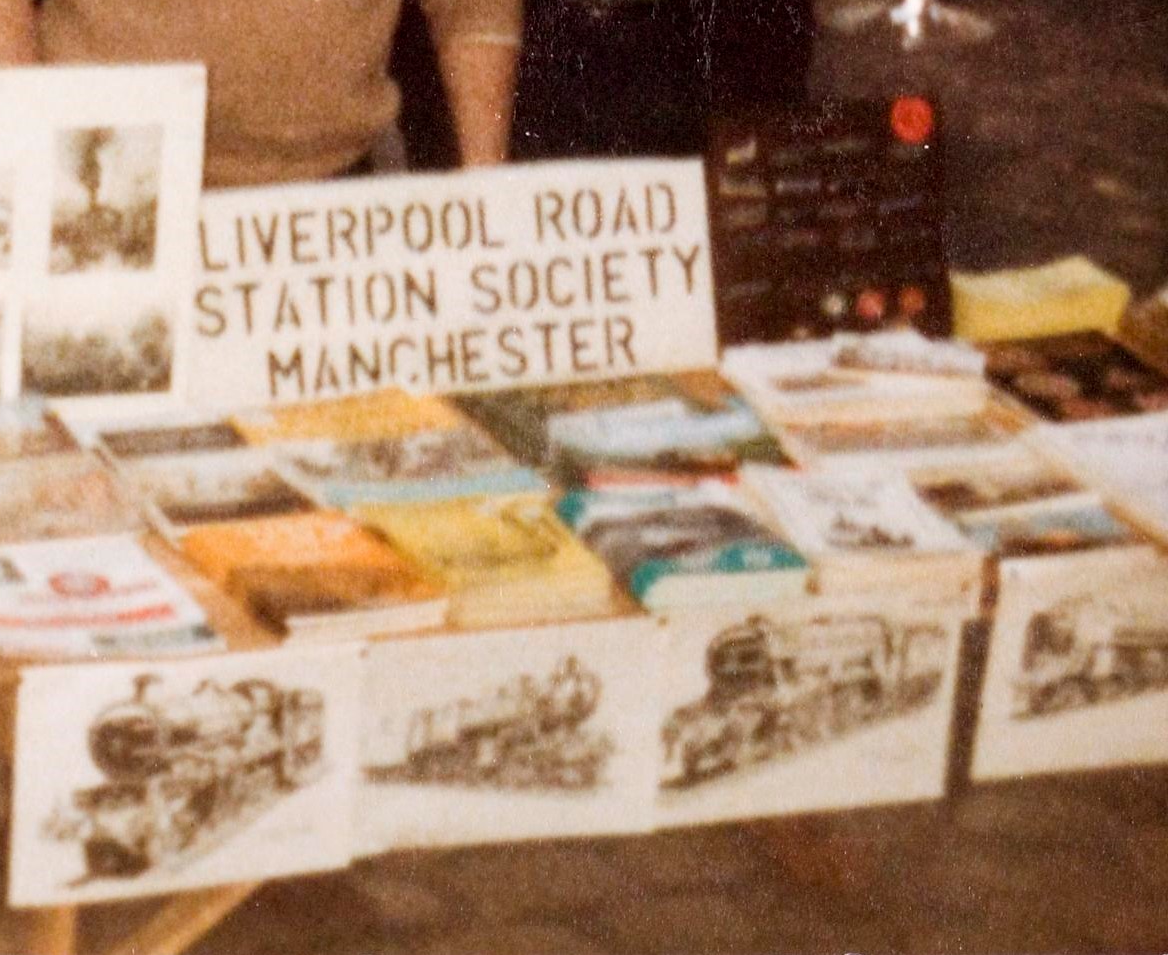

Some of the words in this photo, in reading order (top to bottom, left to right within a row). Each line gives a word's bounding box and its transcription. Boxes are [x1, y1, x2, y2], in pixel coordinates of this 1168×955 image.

[199, 200, 504, 272] LIVERPOOL
[535, 183, 677, 239] ROAD
[194, 271, 437, 336] STATION
[471, 247, 701, 314] SOCIETY
[268, 316, 638, 396] MANCHESTER
